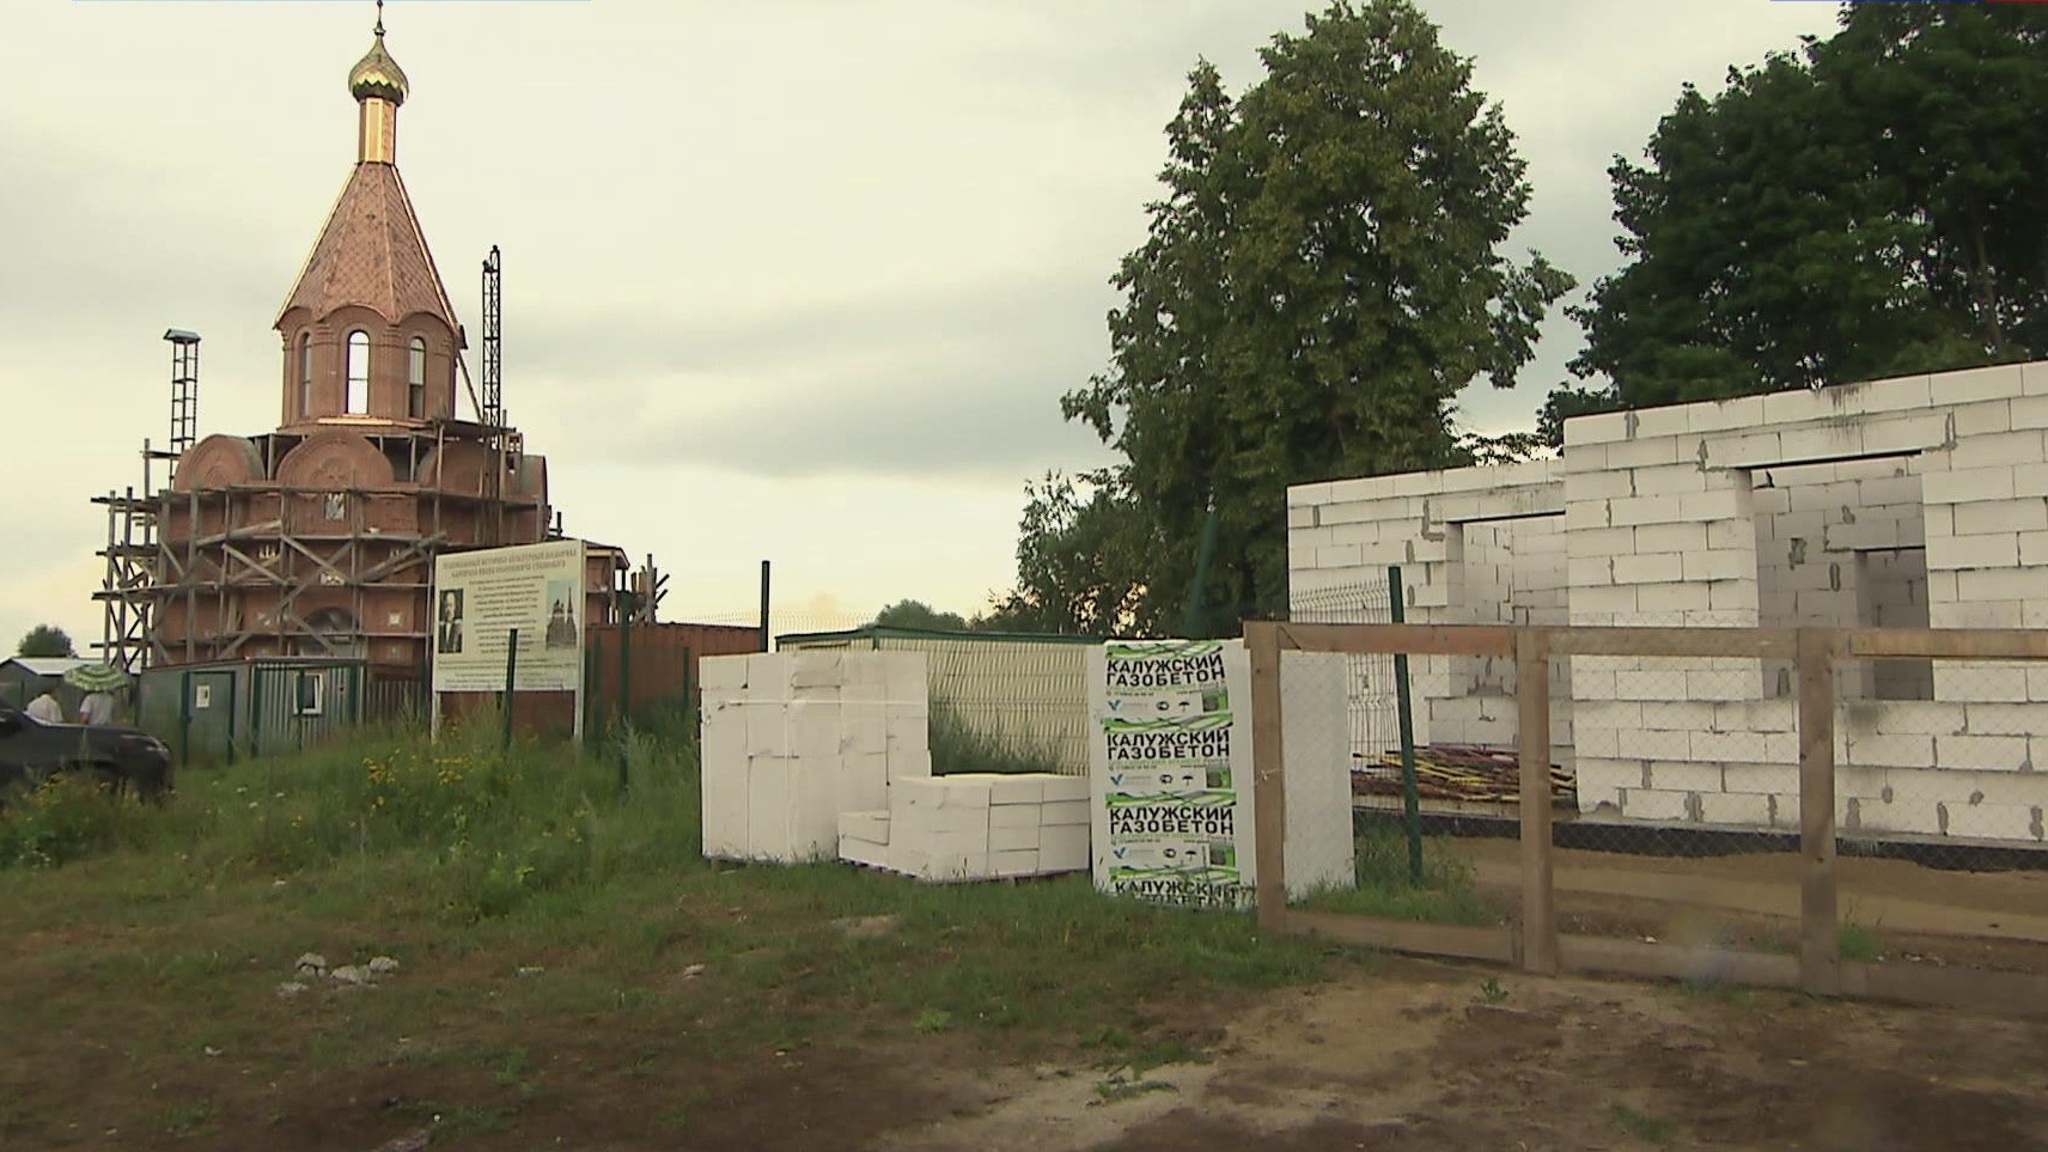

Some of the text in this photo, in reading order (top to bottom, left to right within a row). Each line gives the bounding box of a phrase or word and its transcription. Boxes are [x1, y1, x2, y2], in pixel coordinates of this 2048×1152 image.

[1106, 666, 1226, 687] ГАЗОБЕТОН
[1107, 743, 1230, 760] ГАЗОБЕТОН
[1110, 819, 1234, 836] ГАЗОБЕТОН
